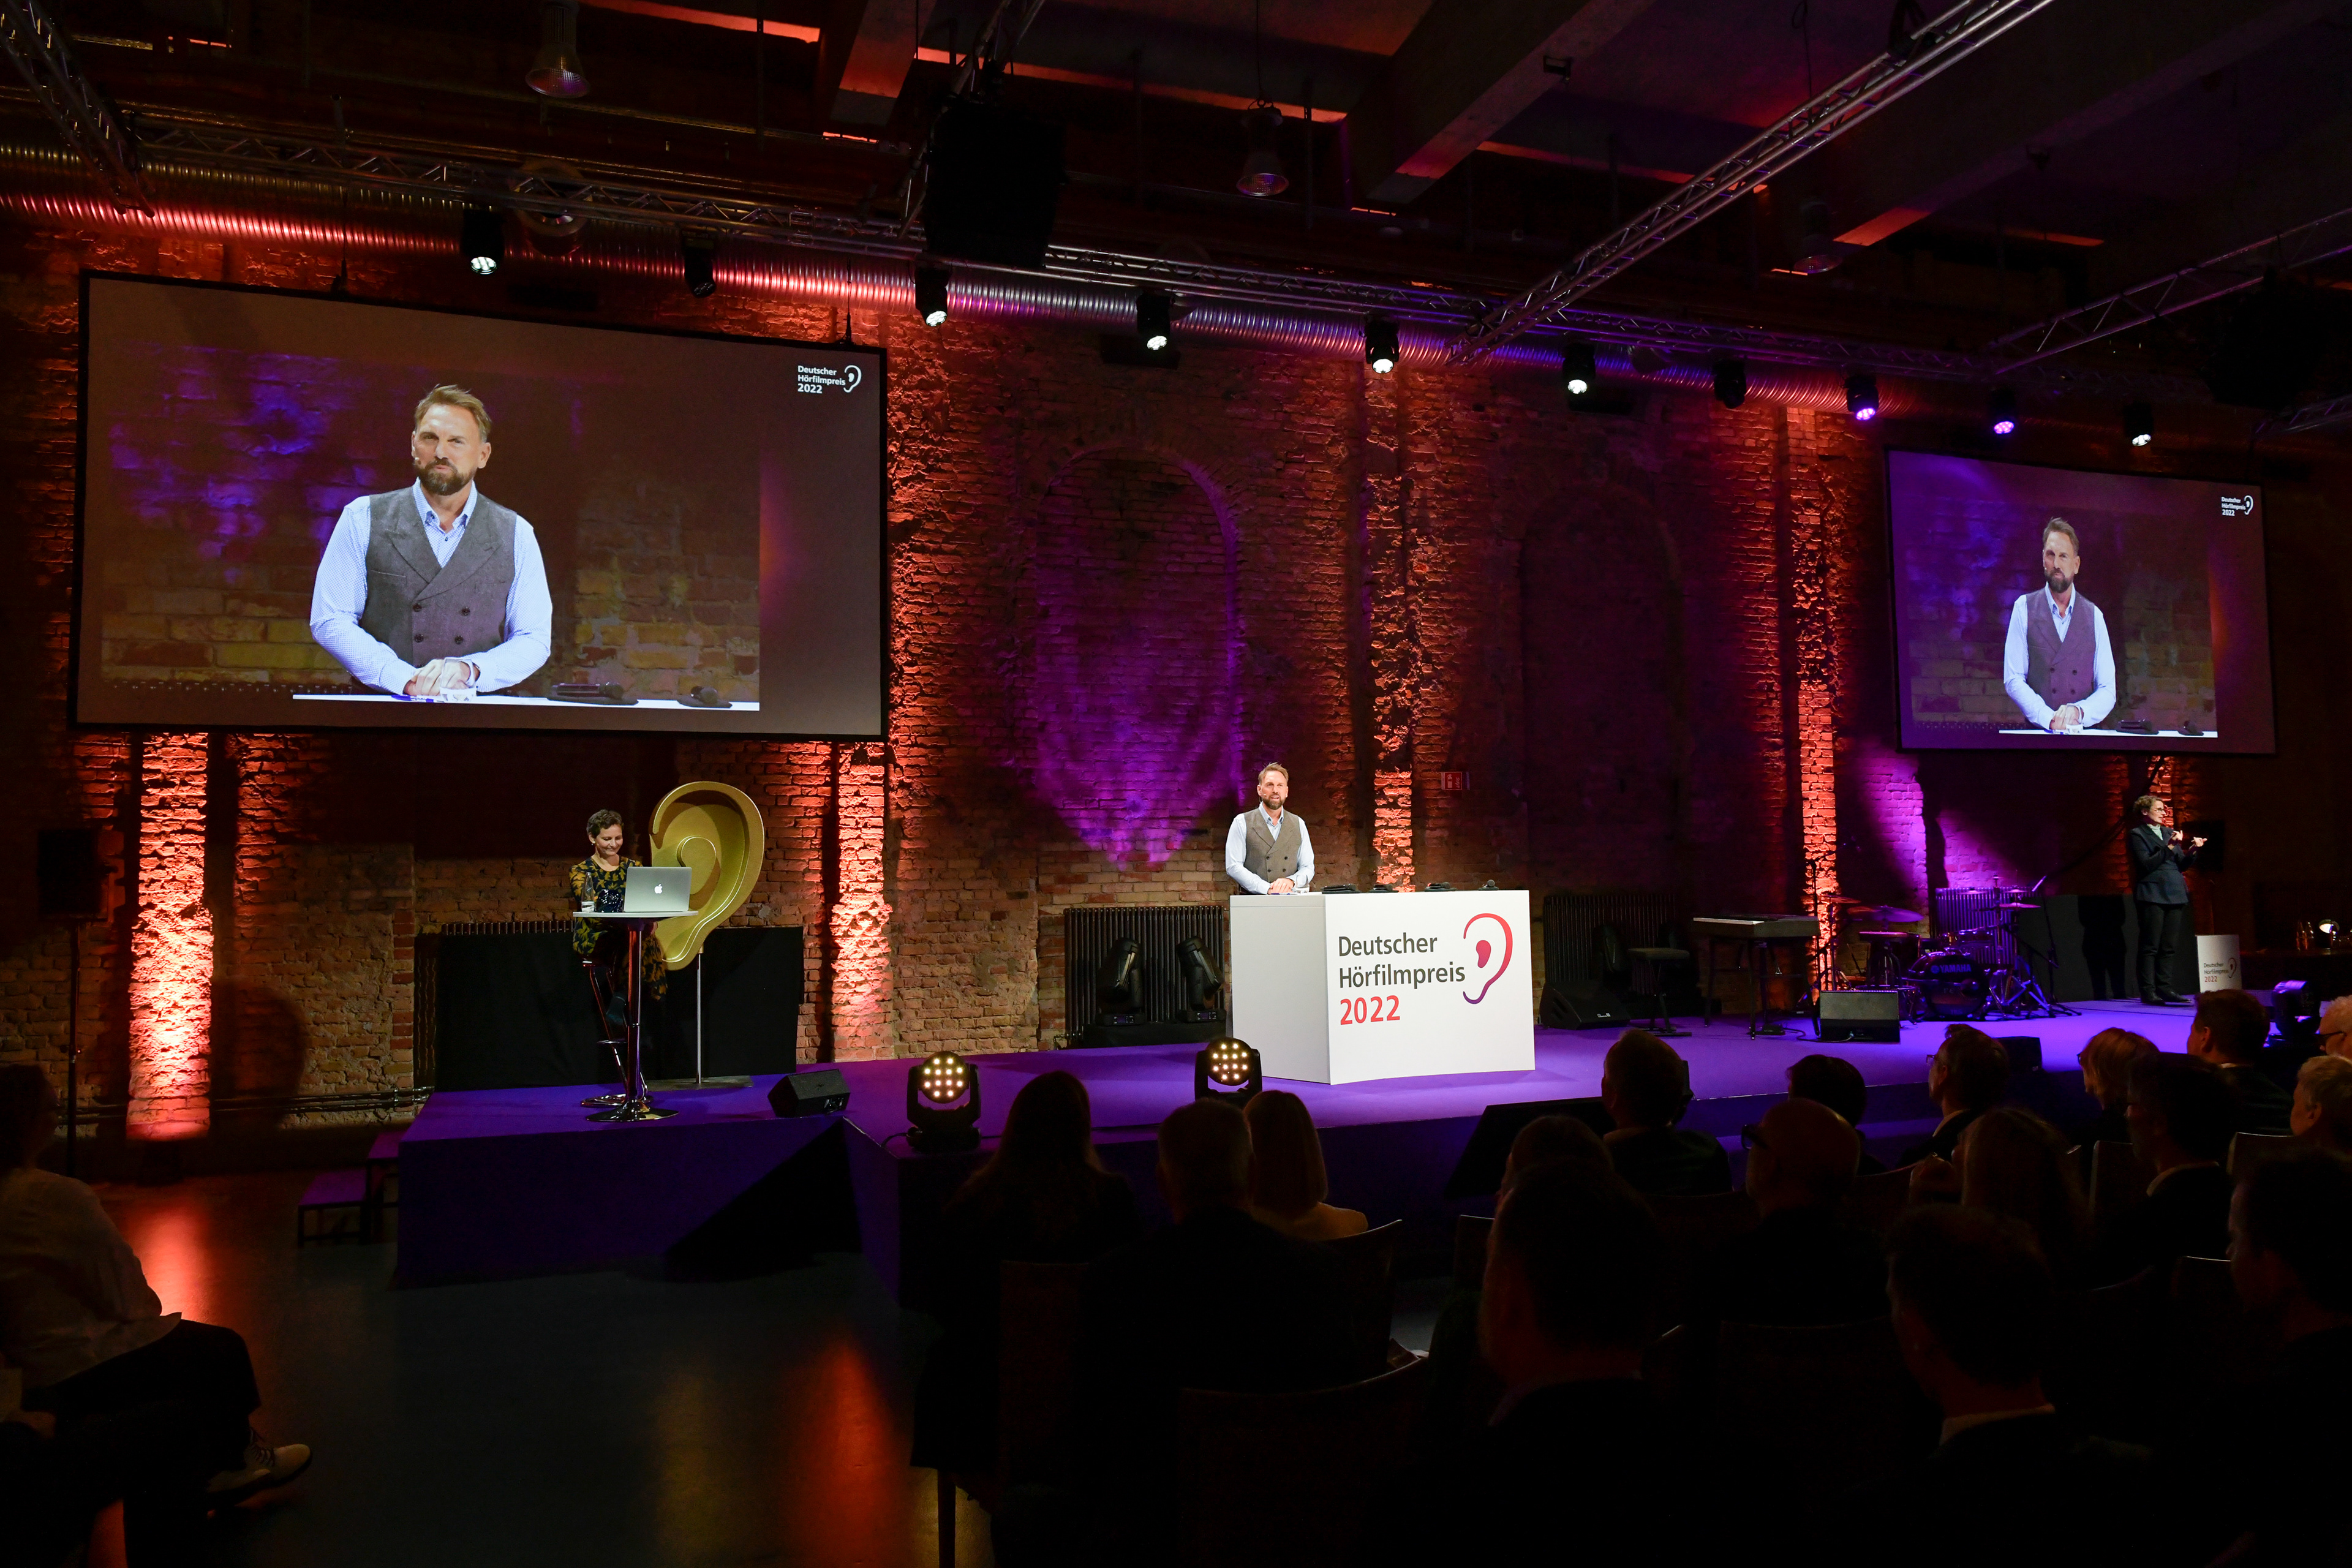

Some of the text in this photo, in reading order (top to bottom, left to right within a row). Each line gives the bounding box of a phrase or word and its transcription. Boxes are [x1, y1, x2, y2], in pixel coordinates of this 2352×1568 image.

[797, 365, 837, 375] Deutscher
[797, 374, 846, 386] Hörfilmpreis
[797, 383, 823, 394] 2022
[1339, 932, 1438, 957] Deutscher
[1939, 964, 1972, 973] YAMAHA
[1340, 962, 1465, 989] Hörfilmpreis
[1340, 995, 1400, 1025] 2022
